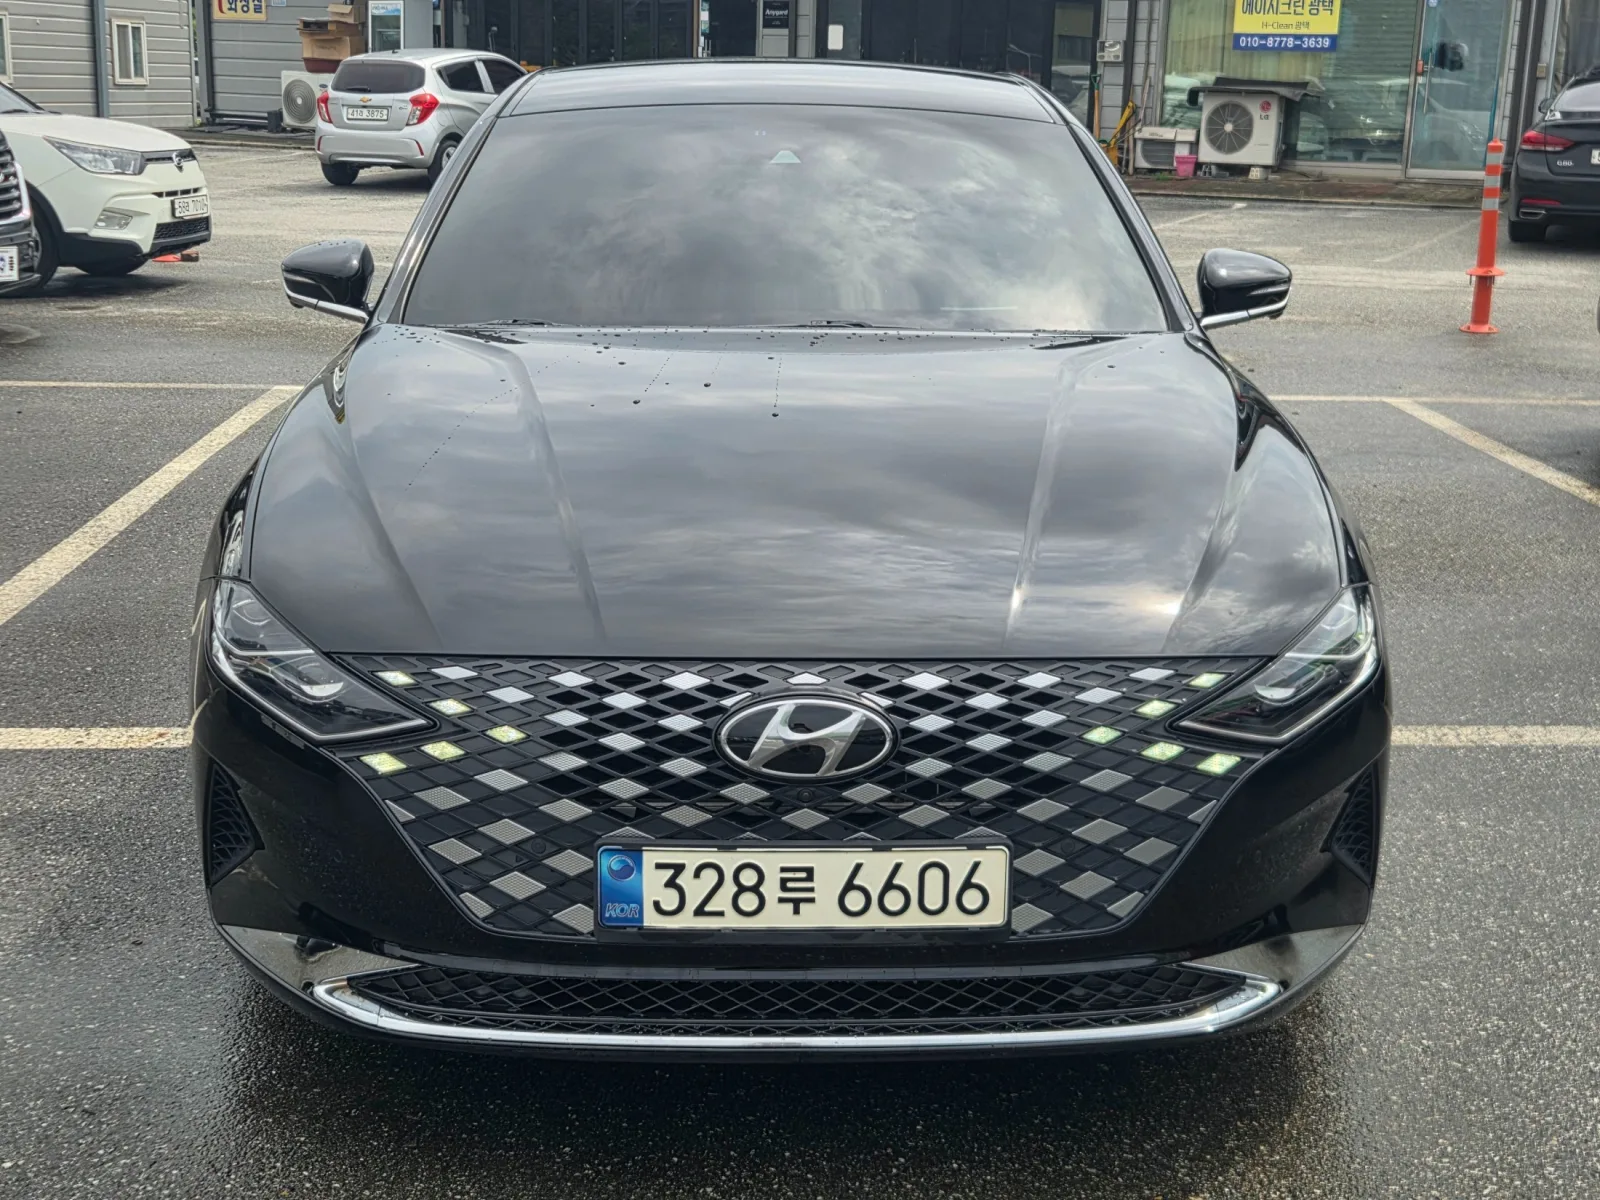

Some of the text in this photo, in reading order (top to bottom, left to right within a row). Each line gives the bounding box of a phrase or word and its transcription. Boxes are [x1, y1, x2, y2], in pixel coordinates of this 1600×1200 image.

[1308, 0, 1334, 15] 광택
[1261, 21, 1294, 30] H-Clean
[1239, 36, 1330, 48] 010-8778-3639
[366, 109, 385, 118] 3875
[652, 861, 991, 918] 328루 6606
[605, 903, 639, 918] KOR
